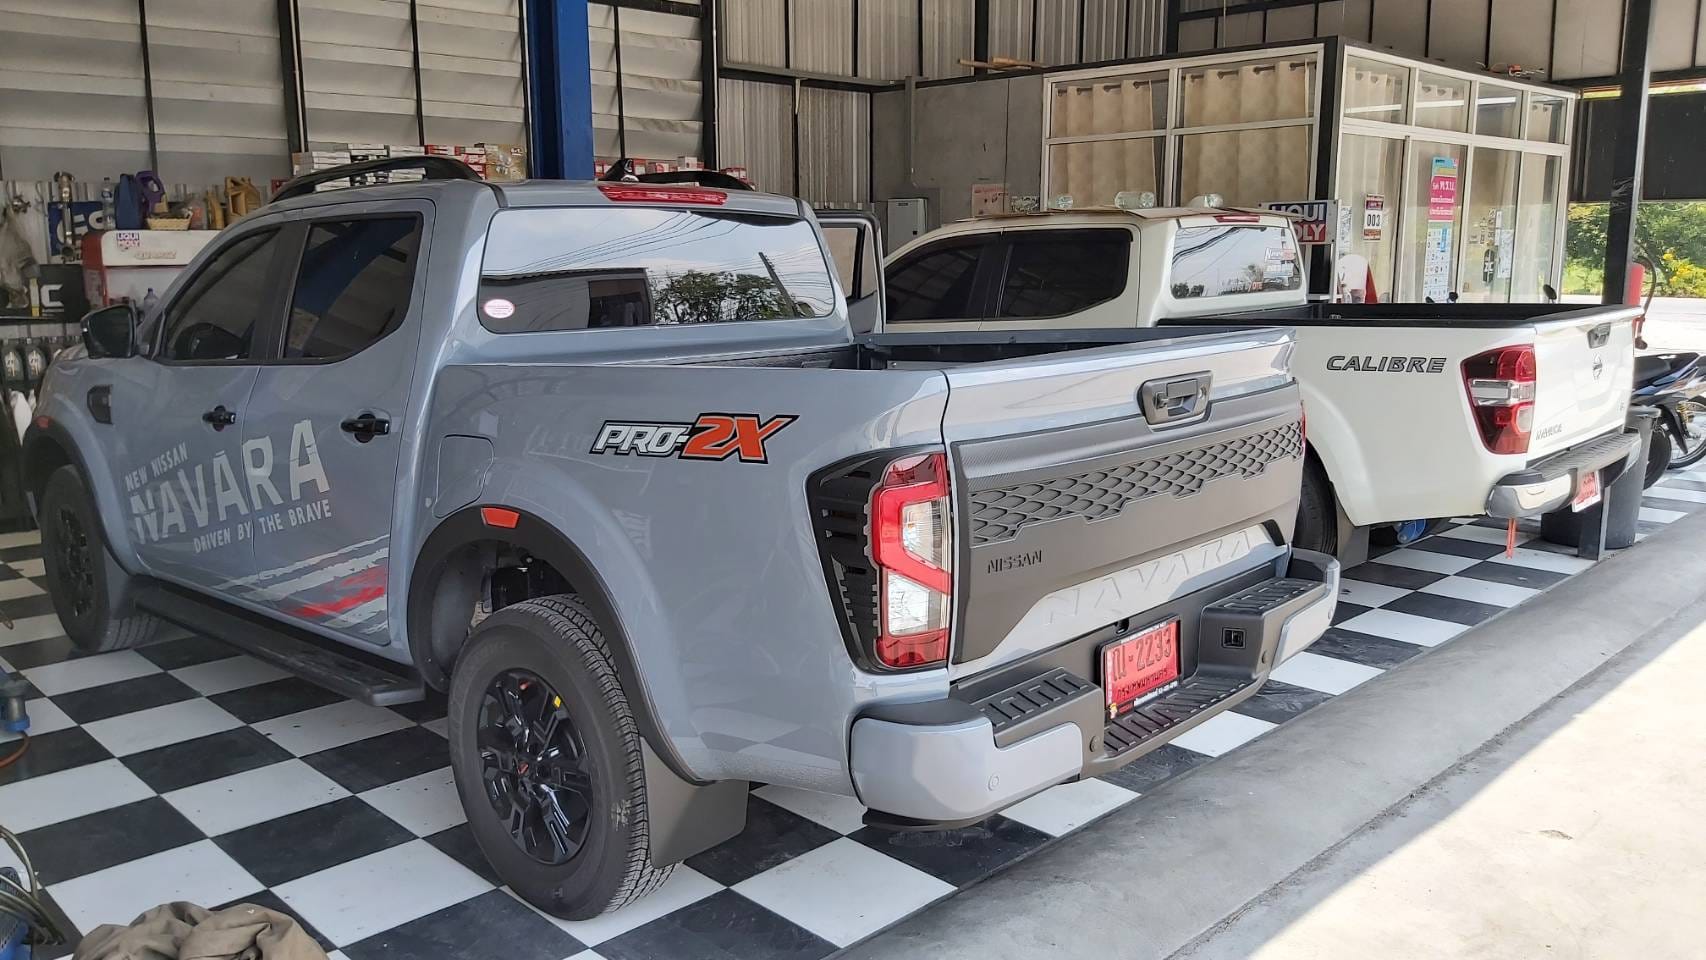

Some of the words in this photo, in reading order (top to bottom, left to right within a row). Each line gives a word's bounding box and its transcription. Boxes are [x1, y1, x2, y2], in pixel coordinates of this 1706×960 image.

[1293, 223, 1325, 241] OLY
[1366, 214, 1381, 227] 003
[1326, 355, 1447, 374] CALIBRE
[589, 412, 800, 464] PRO-2X
[125, 471, 148, 492] NEW
[151, 441, 189, 479] NISSAN
[193, 527, 232, 554] DRIVEN
[237, 520, 253, 542] BY
[259, 512, 284, 536] THE
[287, 498, 333, 528] BRAVE
[987, 549, 1044, 574] NISSAN
[1048, 529, 1250, 624] NAVARA
